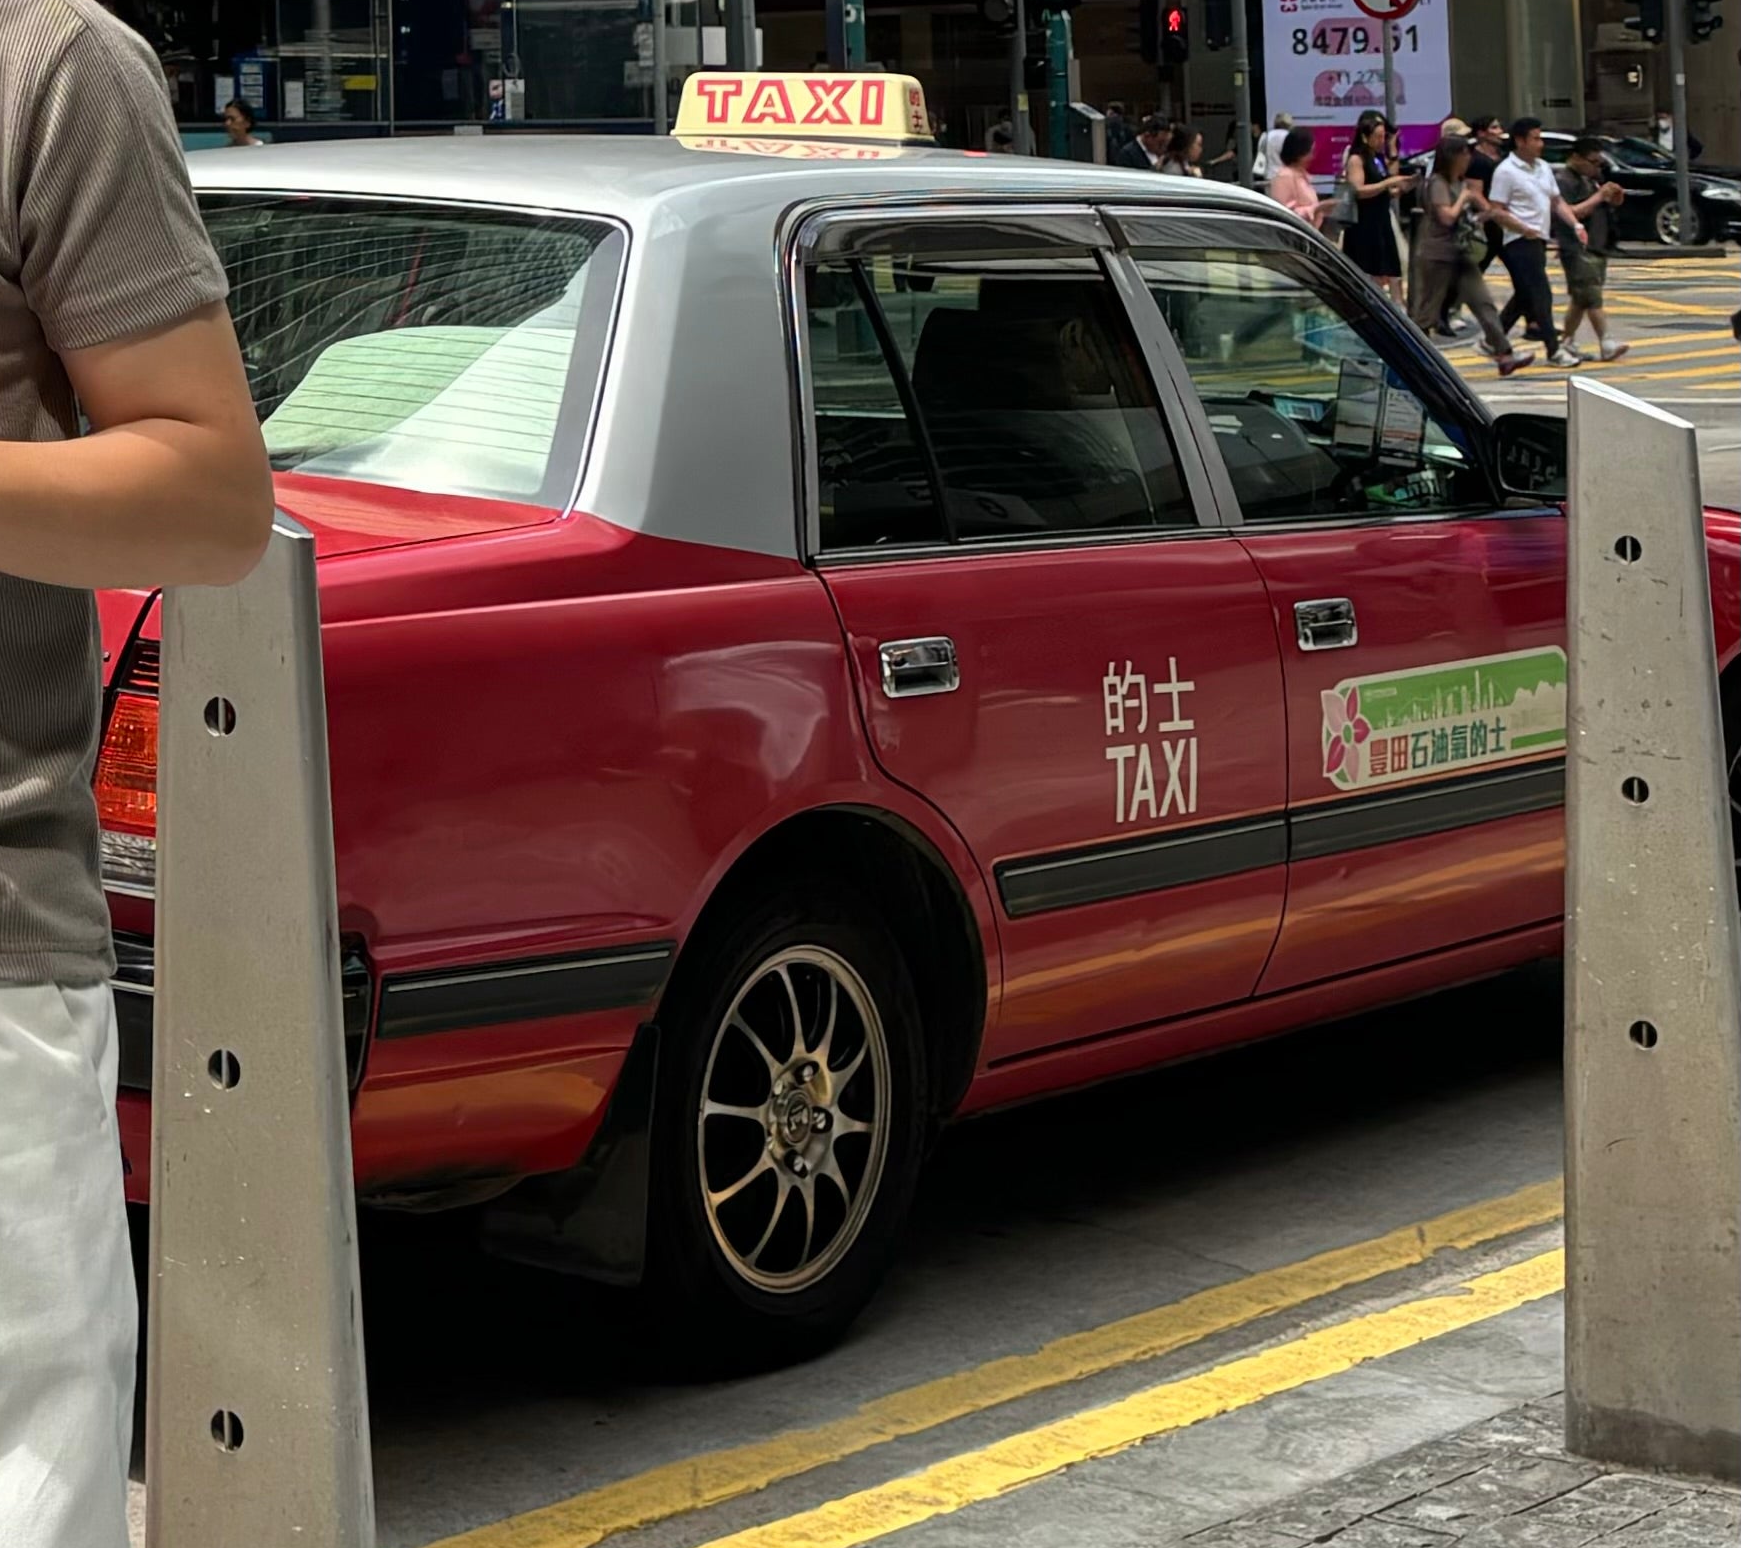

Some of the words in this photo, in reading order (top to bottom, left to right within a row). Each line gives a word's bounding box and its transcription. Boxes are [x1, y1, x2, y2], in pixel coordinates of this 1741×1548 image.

[697, 79, 885, 125] TAXI
[1103, 657, 1196, 736] 的士
[1106, 737, 1198, 823] TAXI
